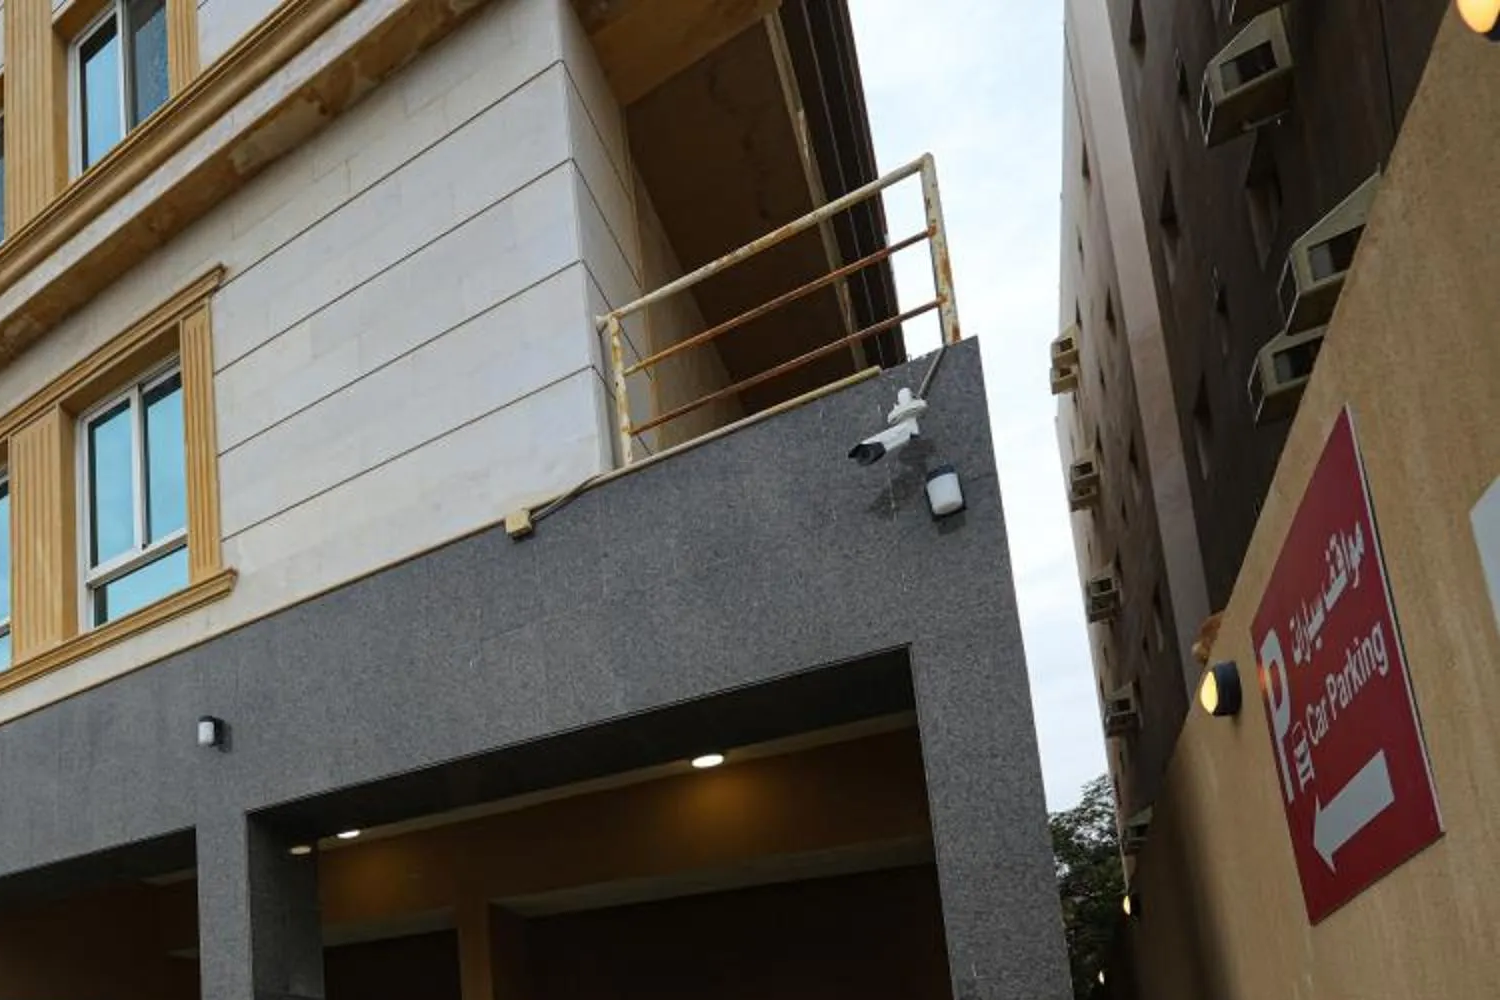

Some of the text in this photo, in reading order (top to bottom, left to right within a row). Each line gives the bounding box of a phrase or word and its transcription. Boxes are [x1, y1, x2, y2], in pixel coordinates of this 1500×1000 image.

[1289, 520, 1364, 665] مواقف سيارات
[1260, 628, 1295, 804] P
[1306, 621, 1389, 746] Car Parking
